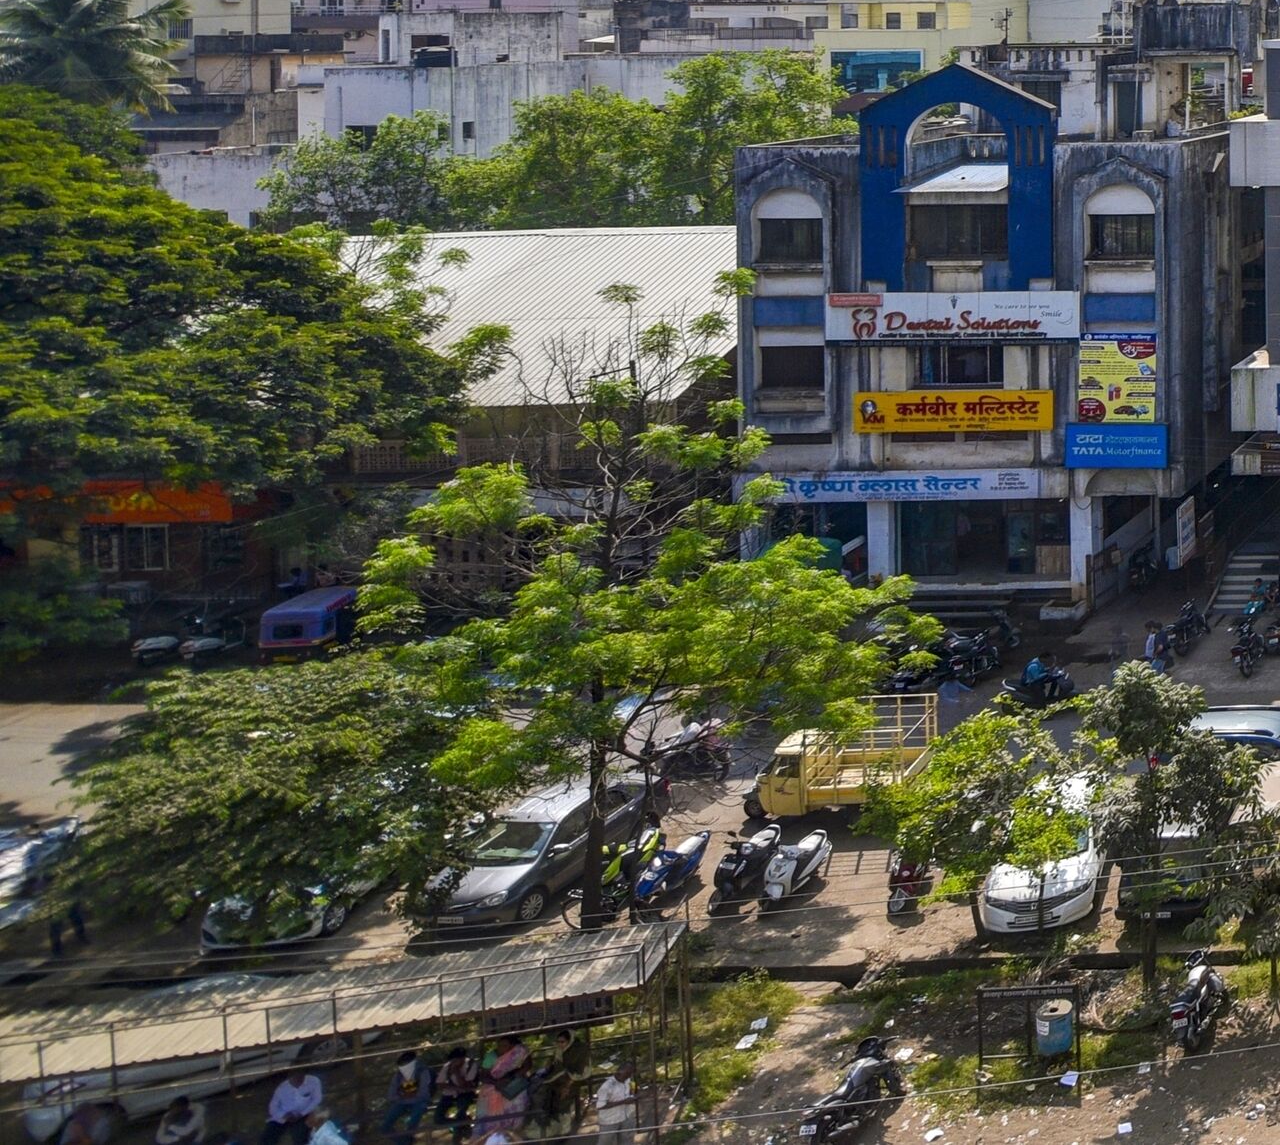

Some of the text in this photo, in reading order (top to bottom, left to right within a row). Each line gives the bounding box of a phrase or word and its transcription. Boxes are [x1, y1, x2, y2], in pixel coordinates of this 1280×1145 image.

[1039, 309, 1063, 318] Smile
[883, 309, 1042, 332] Dental Solutions
[895, 394, 1040, 417] कर्मवीर मल्टिस्टेट
[1075, 434, 1104, 444] टाटा
[1071, 446, 1162, 458] TATA Motorfinance
[857, 479, 919, 493] ग्लास
